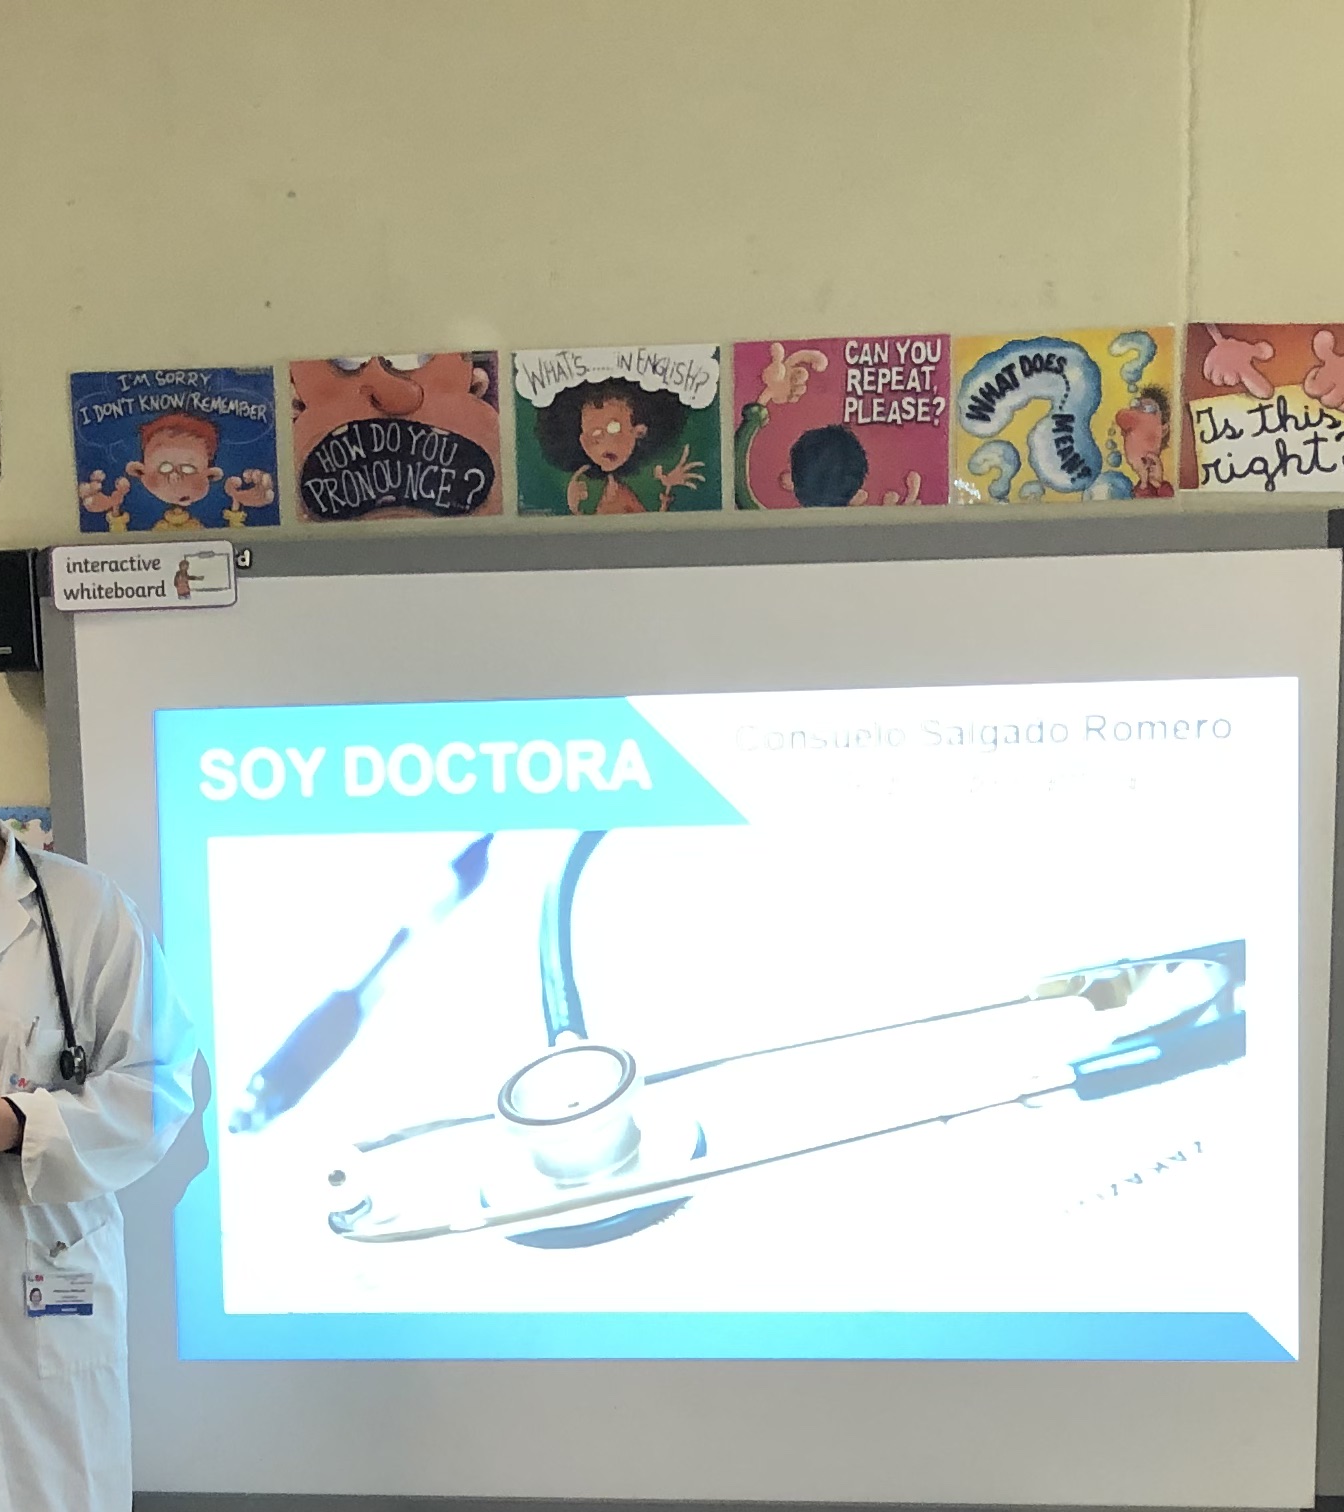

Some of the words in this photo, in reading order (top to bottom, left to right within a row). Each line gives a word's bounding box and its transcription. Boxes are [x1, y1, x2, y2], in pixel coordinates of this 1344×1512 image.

[844, 340, 888, 366] CAN
[896, 338, 943, 365] YOU
[117, 373, 151, 393] I'M
[616, 352, 634, 374] IN
[635, 347, 710, 401] ENGLISH?
[845, 366, 940, 396] REPEAT,
[79, 407, 92, 426] I
[92, 396, 136, 424] DON'T
[843, 396, 947, 428] PLEASE?
[965, 362, 1021, 423] WHAT
[1051, 413, 1093, 485] MEAN?
[1196, 405, 1243, 444] Is
[1251, 395, 1343, 436] this
[316, 433, 367, 474] HOW
[369, 422, 401, 454] DO
[407, 425, 459, 467] YOU
[65, 553, 162, 575] interactive
[63, 579, 167, 601] whiteboard
[199, 745, 327, 802] SOY
[344, 738, 654, 800] DOCTORA
[920, 717, 1070, 755] Salgado
[1086, 714, 1234, 743] Romero
